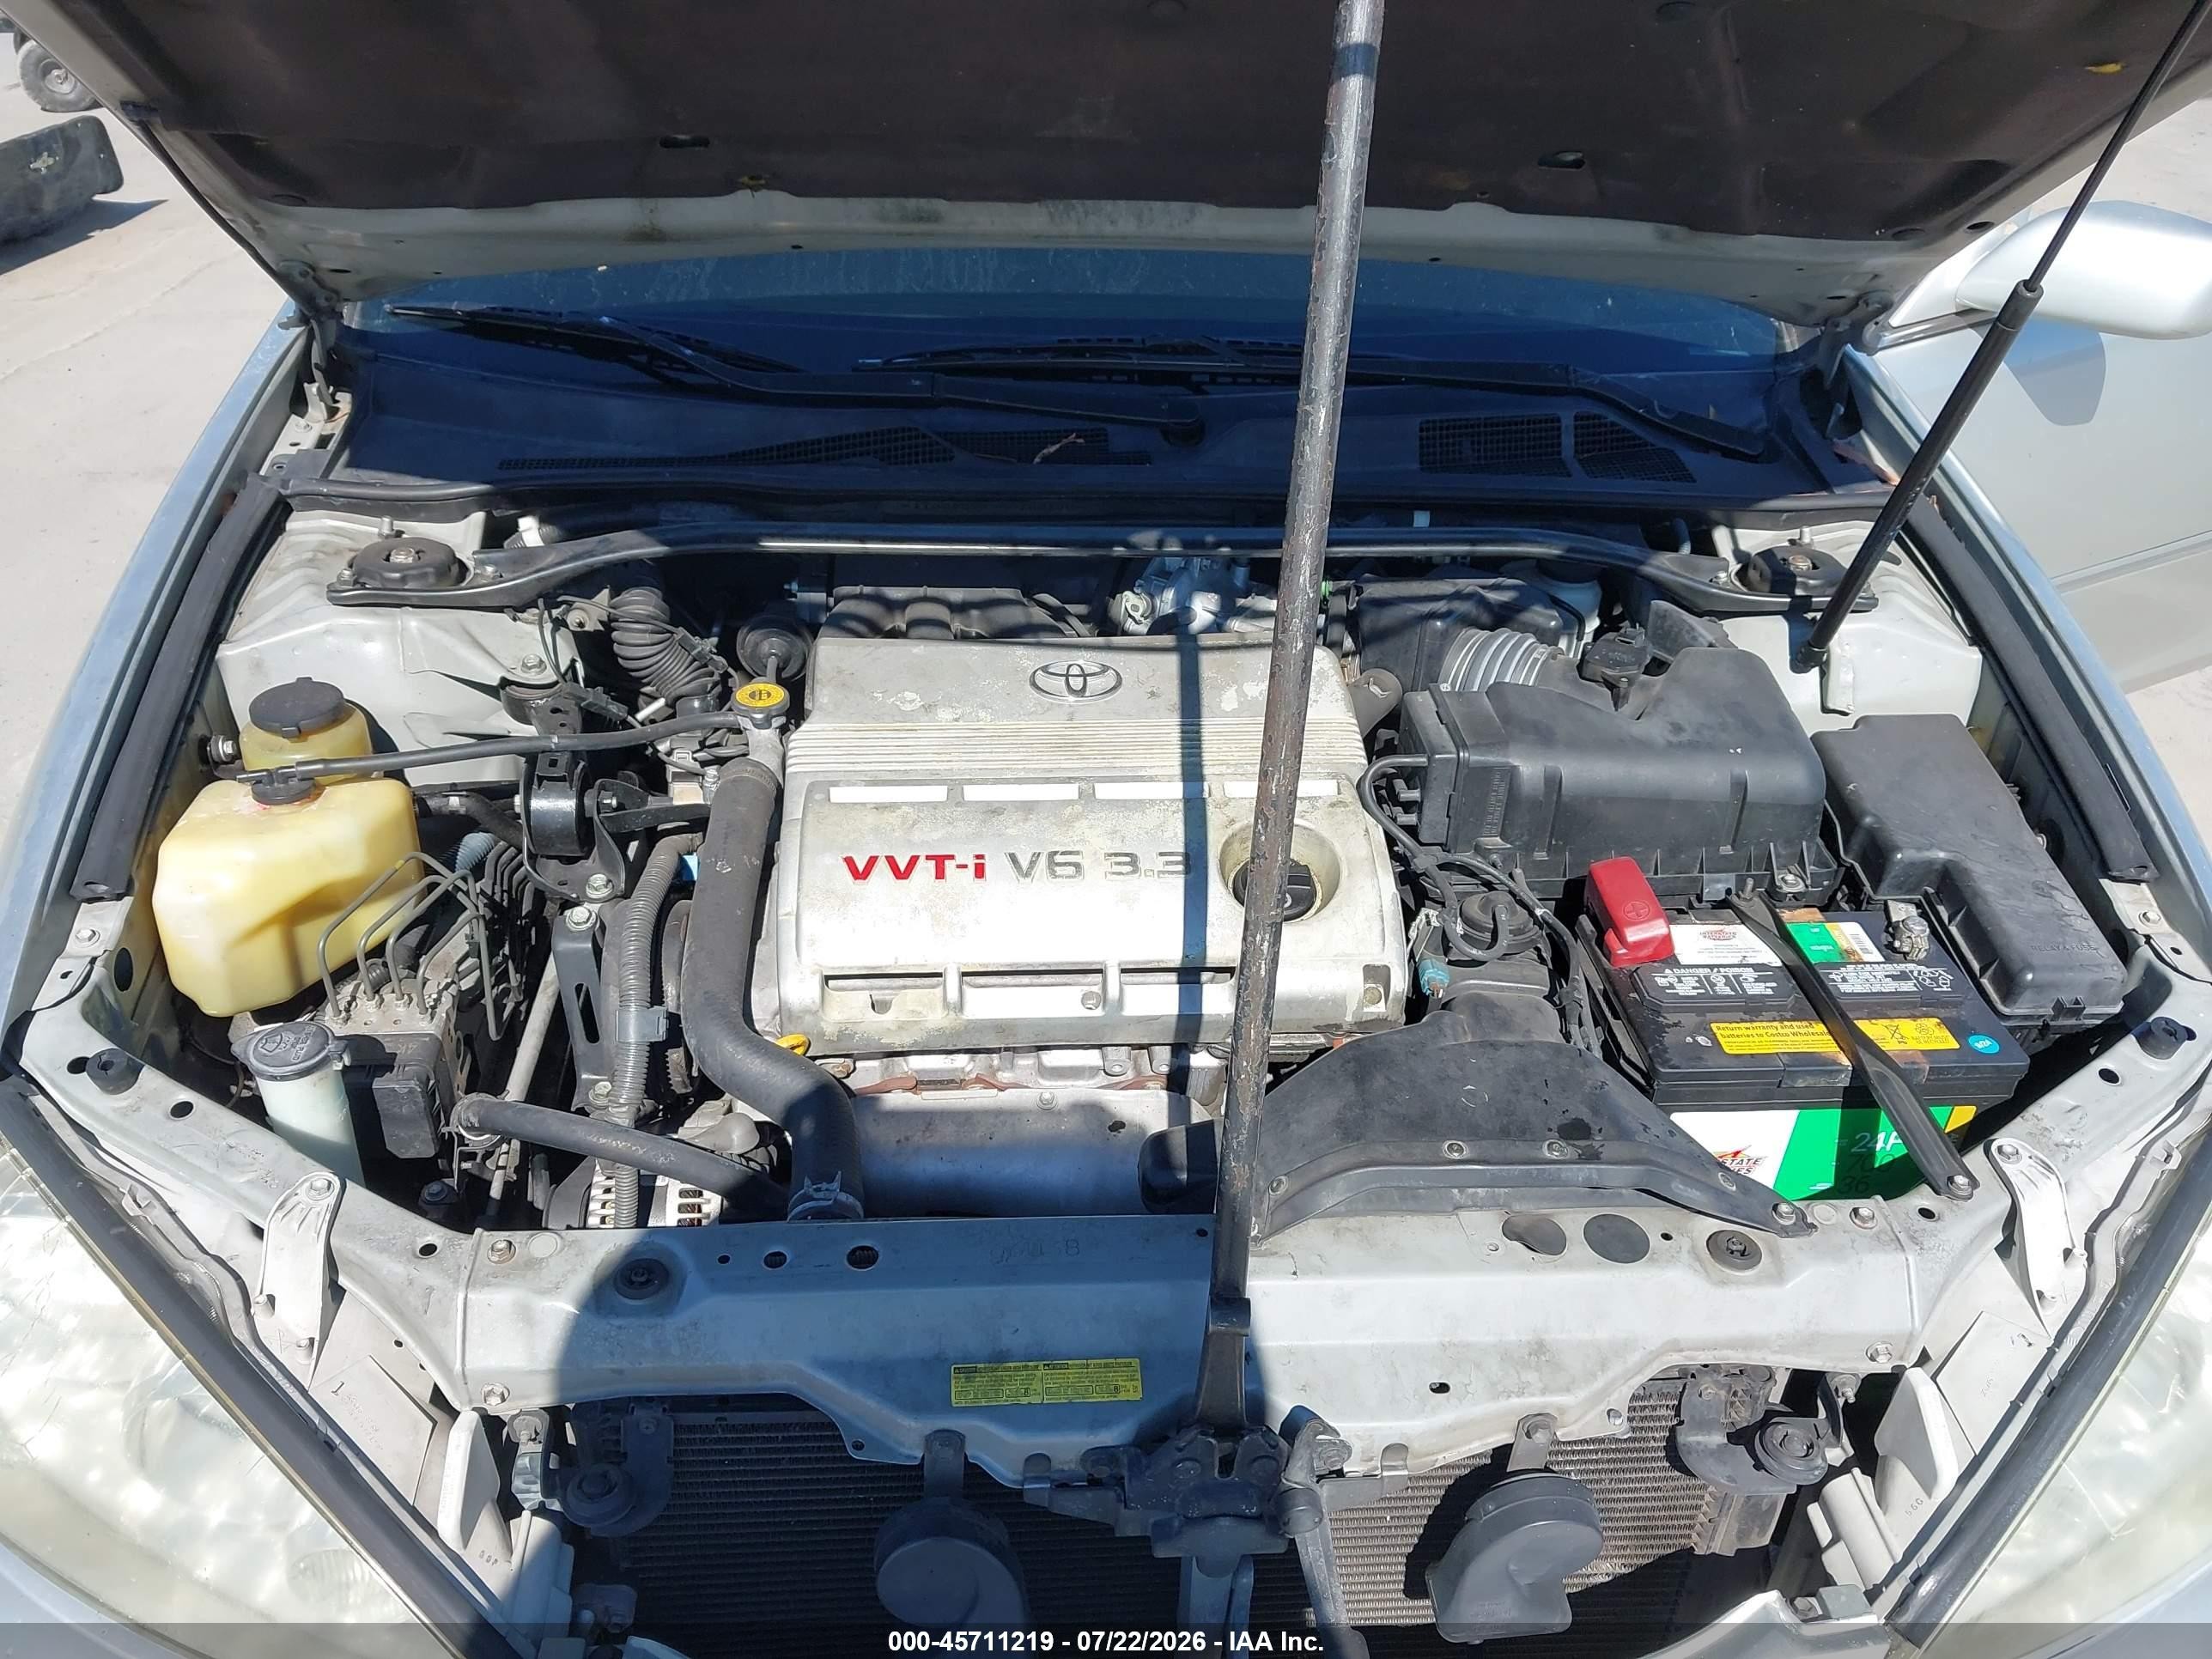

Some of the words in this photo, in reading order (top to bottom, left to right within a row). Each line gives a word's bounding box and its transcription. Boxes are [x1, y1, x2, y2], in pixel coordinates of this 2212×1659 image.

[843, 854, 988, 883] VVT-i
[1005, 850, 1085, 883] V6
[1103, 851, 1192, 880] 3.3
[1721, 1030, 1754, 1039] batteries
[1720, 1158, 1762, 1166] STATE
